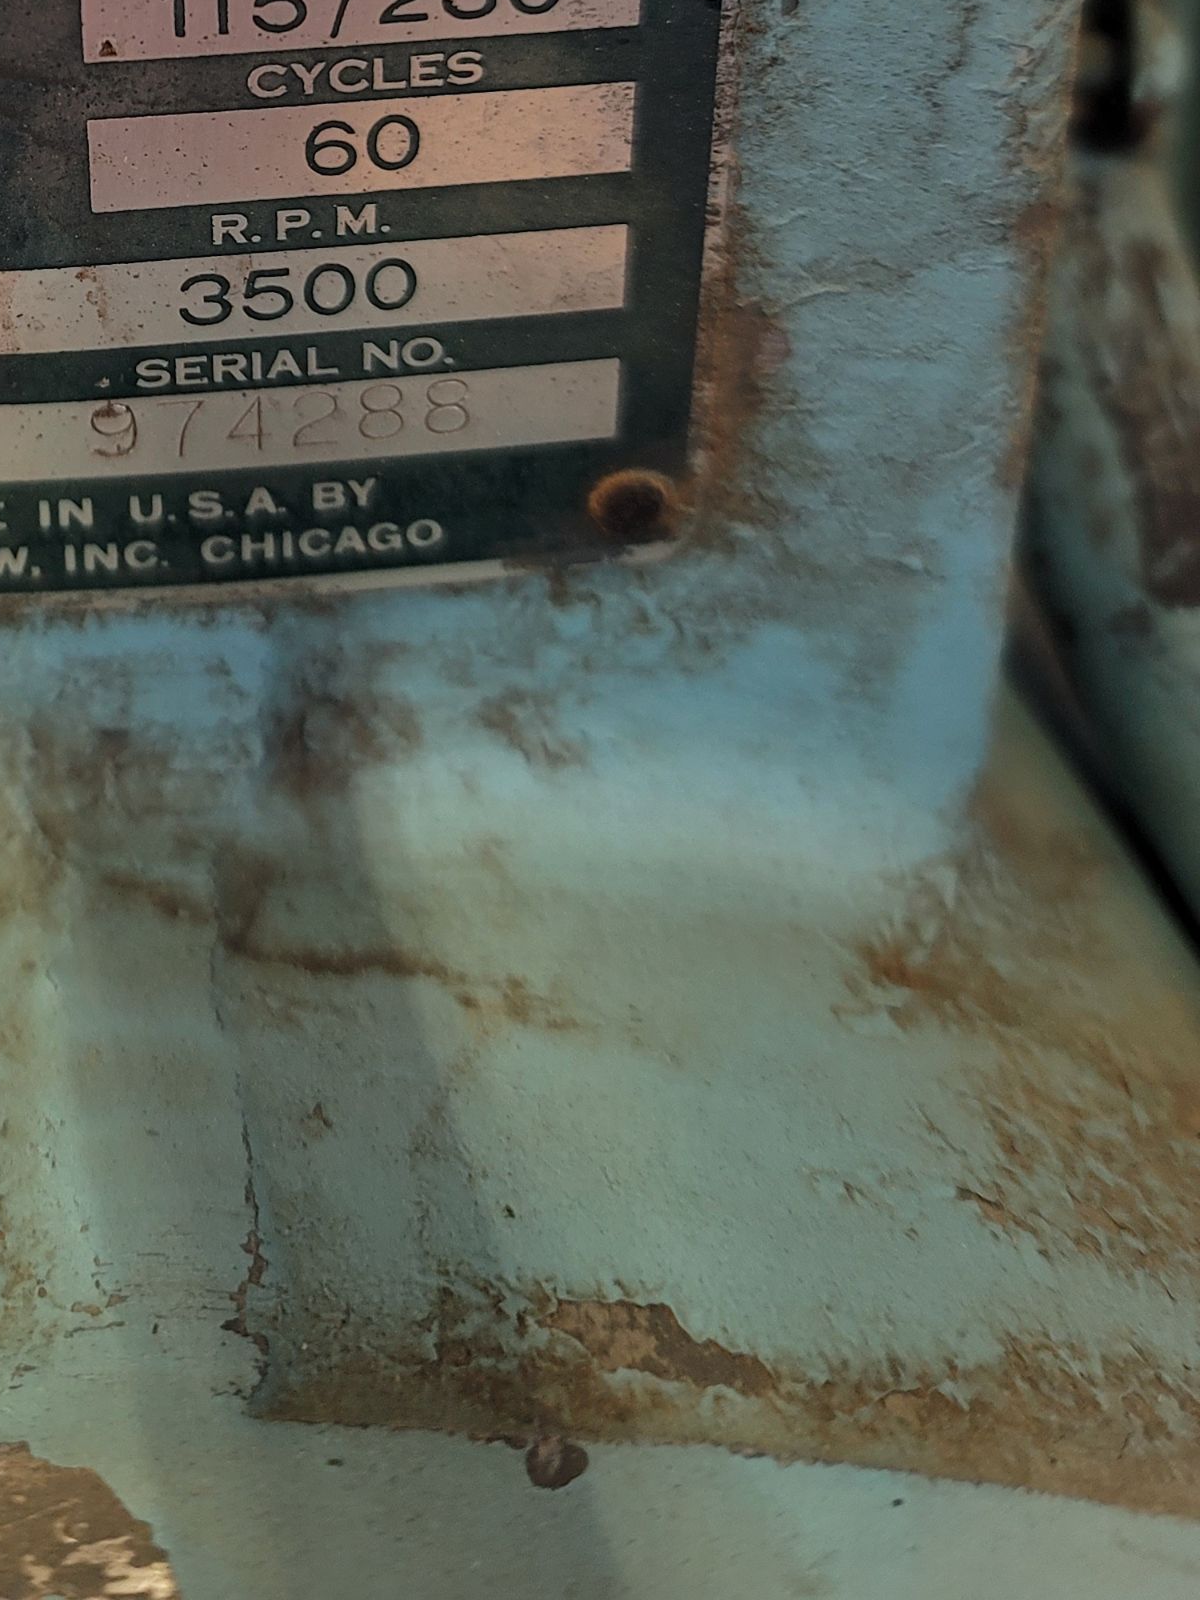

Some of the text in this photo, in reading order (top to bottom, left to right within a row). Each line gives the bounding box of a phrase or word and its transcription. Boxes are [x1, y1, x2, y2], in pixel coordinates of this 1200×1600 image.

[247, 52, 485, 99] CYCLES
[304, 113, 421, 177] 60
[179, 257, 419, 326] 3500
[136, 337, 456, 389] SERIAL NO.
[90, 378, 472, 459] 974288
[39, 499, 93, 527] IN
[312, 477, 379, 509] BY
[64, 541, 169, 573] INC.
[201, 519, 444, 564] CHICAGO
